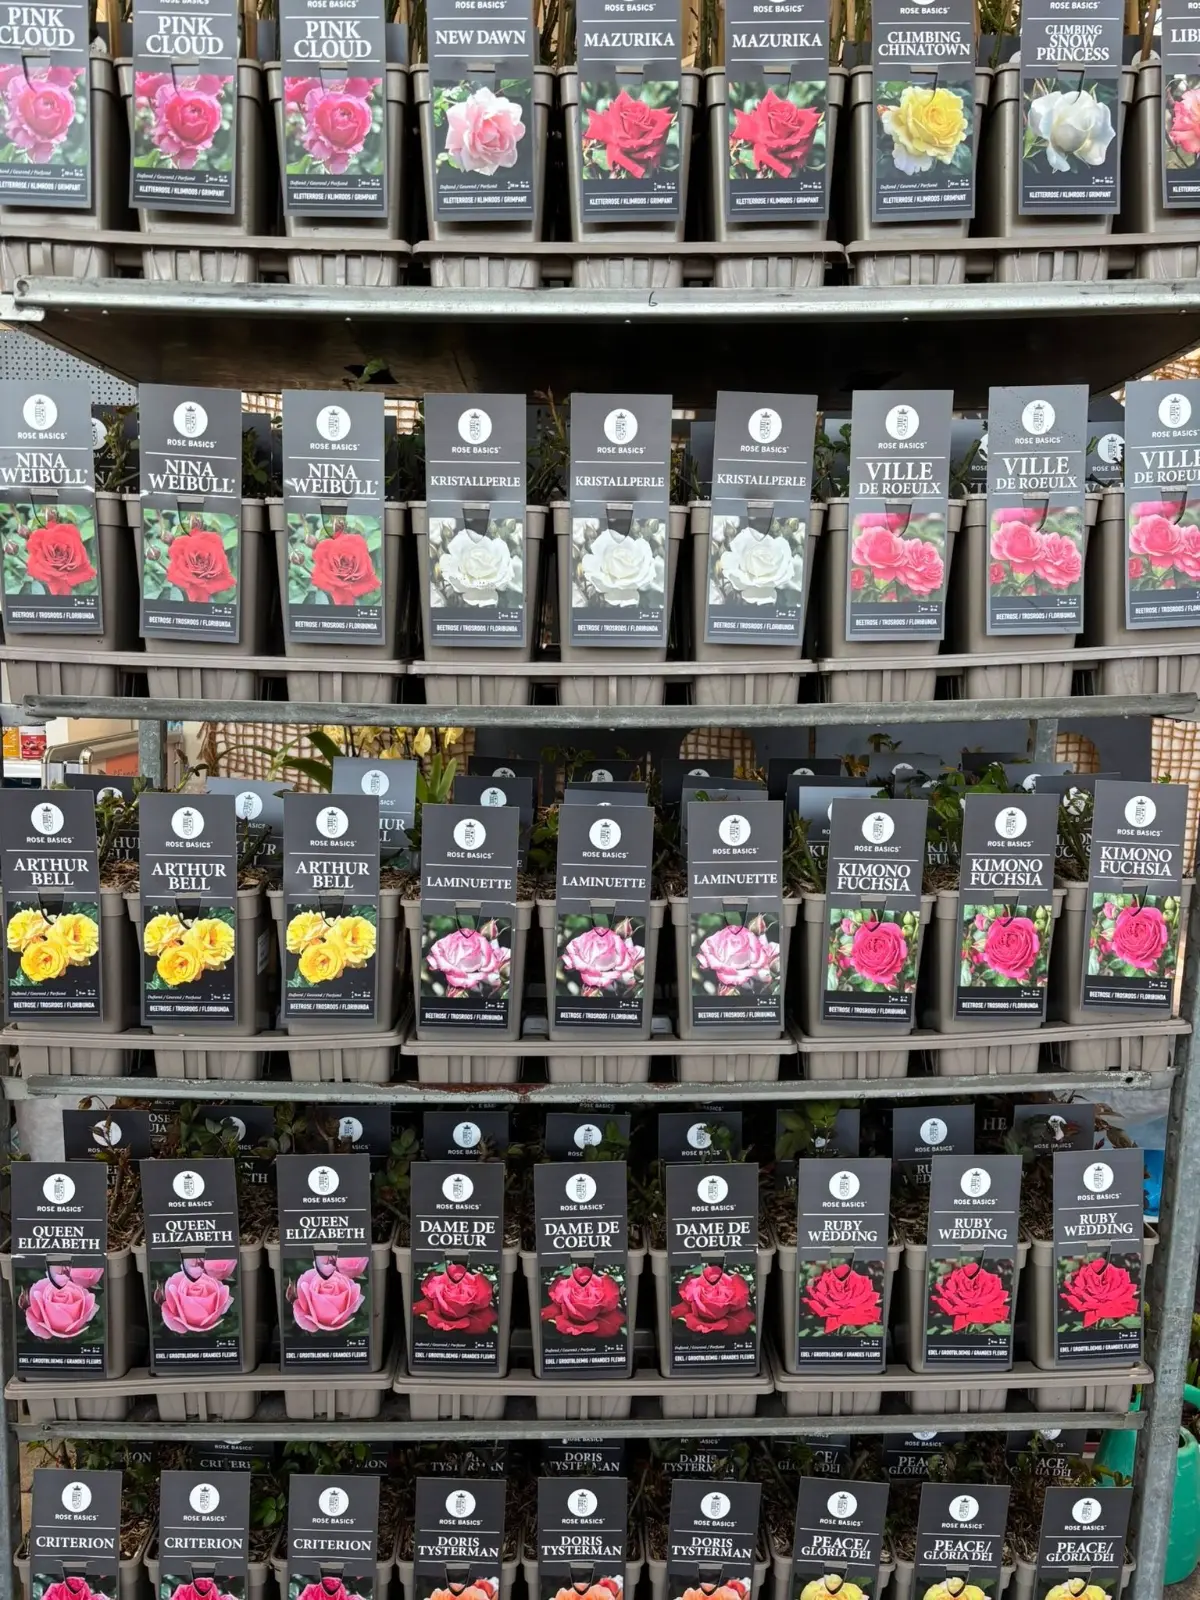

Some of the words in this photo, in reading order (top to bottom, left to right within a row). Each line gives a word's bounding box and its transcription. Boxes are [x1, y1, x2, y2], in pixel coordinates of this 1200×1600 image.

[8, 7, 64, 27] PINK
[158, 16, 213, 35] PINK
[306, 21, 361, 39] PINK
[1045, 25, 1102, 37] CLIMBING
[0, 26, 75, 47] CLOUD
[435, 30, 474, 44] NEW
[477, 30, 526, 44] DAWN
[584, 33, 675, 46] MAZURIKA
[732, 33, 822, 47] MAZURIKA
[888, 31, 960, 43] CLIMBING
[1049, 34, 1097, 48] SNOW
[1171, 29, 1200, 42] LIB
[146, 35, 223, 55] CLOUD
[294, 40, 372, 58] CLOUD
[878, 44, 970, 56] CHINATOWN
[1037, 45, 1109, 61] PRINCESS
[167, 438, 188, 447] ROSE
[16, 452, 67, 470] NINA
[1002, 457, 1069, 475] VILLE
[165, 459, 215, 477] NINA
[308, 463, 358, 479] NINA
[866, 462, 933, 480] VILLE
[431, 476, 520, 487] KRISTALLPERLE
[576, 476, 664, 487] KRISTALLPERLE
[717, 474, 806, 486] KRISTALLPERLE
[996, 478, 1016, 489] DE
[1019, 476, 1078, 489] ROEULX
[1134, 472, 1153, 483] DE
[859, 483, 878, 494] DE
[882, 483, 941, 494] ROEULX
[1101, 847, 1172, 862] KIMONO
[14, 858, 89, 872] ARTHUR
[151, 863, 226, 876] ARTHUR
[295, 861, 369, 875] ARTHUR
[838, 863, 910, 877] KIMONO
[971, 859, 1043, 872] KIMONO
[1100, 860, 1172, 876] FUCHSIA
[31, 872, 74, 885] BELL
[169, 877, 210, 890] BELL
[313, 875, 353, 888] BELL
[427, 877, 511, 889] LAMINUETTE
[563, 876, 646, 888] LAMINUETTE
[694, 874, 777, 884] LAMINUETTE
[837, 877, 910, 891] FUCHSIA
[970, 872, 1042, 885] FUCHSIA
[300, 1216, 348, 1231] QUEEN
[955, 1218, 992, 1228] RUBY
[1080, 1213, 1117, 1224] RUBY
[166, 1220, 215, 1235] QUEEN
[286, 1226, 364, 1239] ELIZABETH
[420, 1221, 469, 1233] DAME
[473, 1222, 495, 1233] DE
[545, 1222, 593, 1235] DAME
[598, 1221, 619, 1234] DE
[676, 1223, 724, 1235] DAME
[728, 1222, 750, 1234] DE
[824, 1221, 862, 1231] RUBY
[1064, 1223, 1133, 1236] WEDDING
[33, 1226, 84, 1240] QUEEN
[152, 1229, 232, 1243] ELIZABETH
[808, 1231, 877, 1241] WEDDING
[938, 1229, 1007, 1239] WEDDING
[18, 1235, 100, 1249] ELIZABETH
[428, 1234, 486, 1246] COEUR
[553, 1235, 612, 1248] COEUR
[684, 1235, 742, 1248] COEUR
[36, 1536, 114, 1548] CRITERION
[164, 1537, 243, 1549] CRITERION
[293, 1539, 371, 1550] CRITERION
[438, 1537, 479, 1547] DORIS
[561, 1536, 602, 1545] DORIS
[691, 1536, 734, 1548] DORIS
[812, 1536, 869, 1553] PEACE/
[934, 1540, 991, 1554] PEACE/
[418, 1546, 499, 1557] TYSTERMAN
[542, 1546, 622, 1555] TYSTERMAN
[671, 1545, 752, 1559] TYSTERMAN
[801, 1545, 847, 1557] GLORIA
[850, 1546, 871, 1559] DEI
[924, 1548, 969, 1560] GLORIA
[972, 1549, 992, 1561] DEI
[1056, 1542, 1113, 1556] PEACE/
[1046, 1551, 1090, 1561] GLORIA
[1093, 1551, 1114, 1561] DEI
